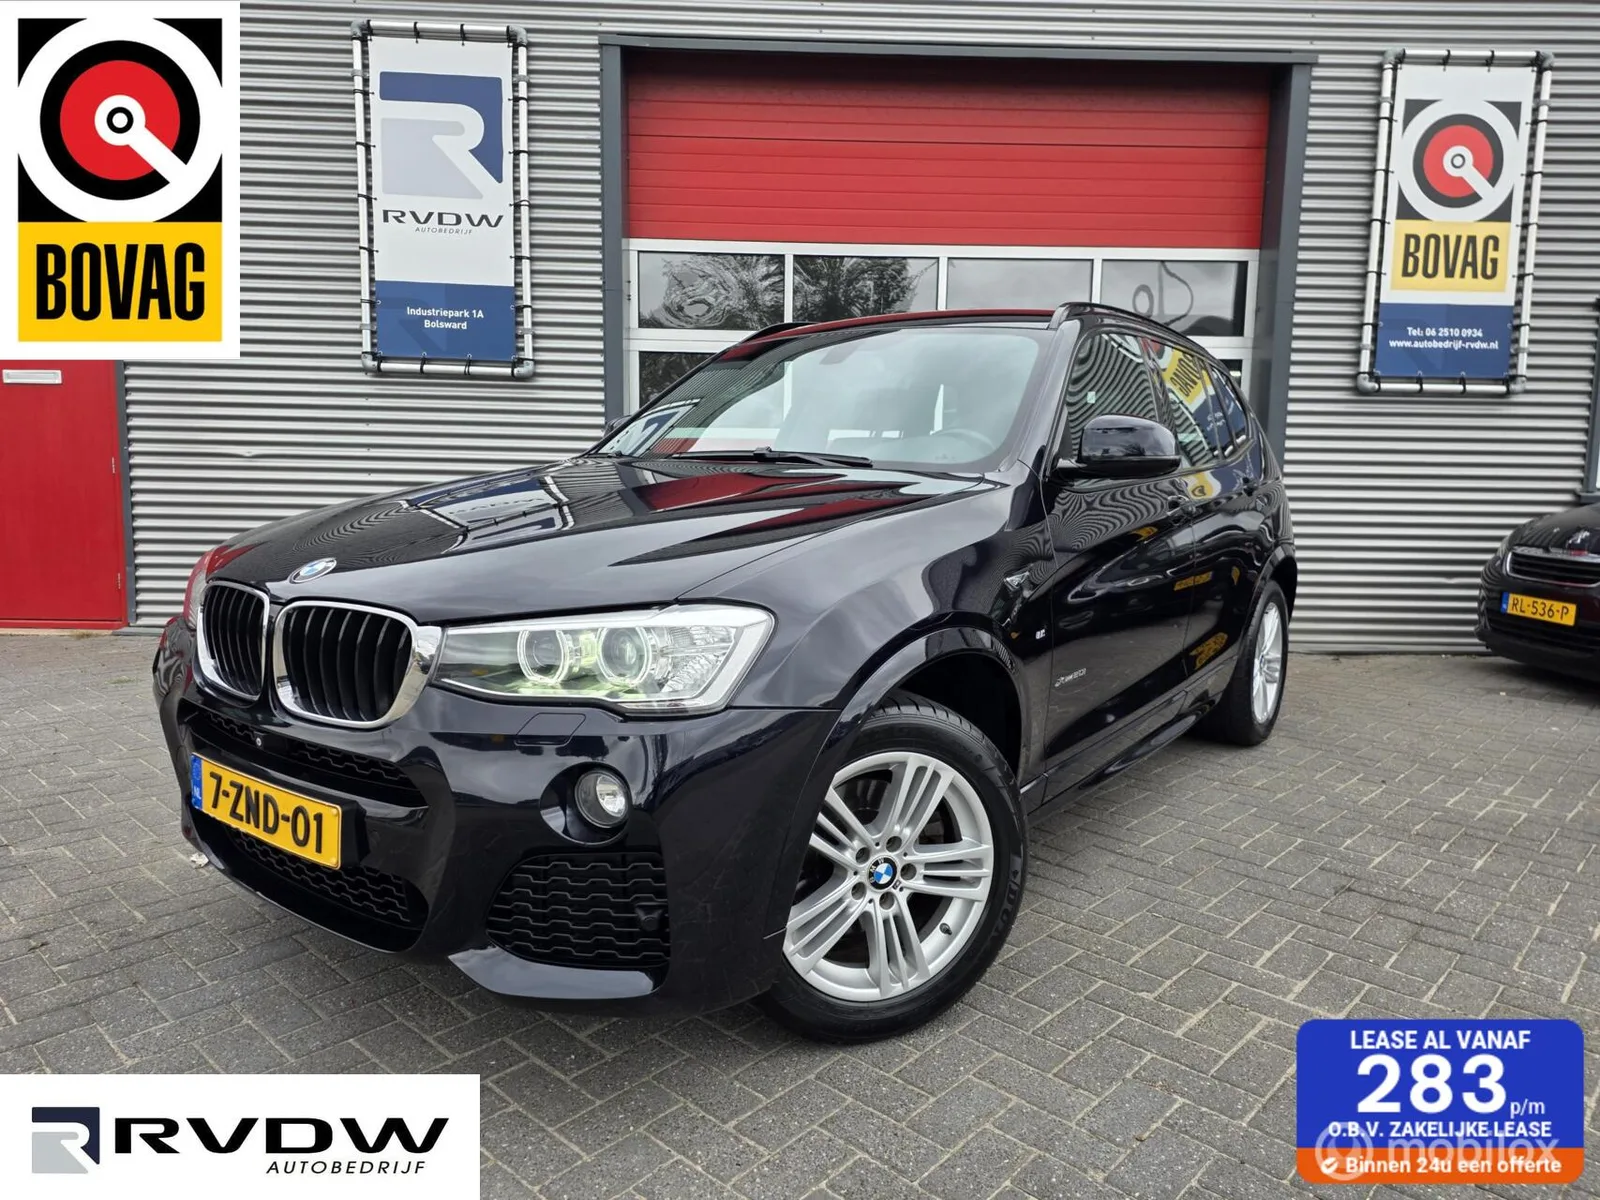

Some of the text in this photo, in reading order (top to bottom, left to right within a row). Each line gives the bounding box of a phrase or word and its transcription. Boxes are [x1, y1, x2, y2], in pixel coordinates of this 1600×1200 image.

[383, 209, 504, 228] RVDW
[415, 227, 473, 235] AUTOBEDRIJF
[1401, 233, 1500, 280] BOVAG
[407, 307, 484, 319] Industriepark 1A
[424, 320, 467, 329] Bolsward
[1407, 327, 1483, 337] Tel: 06 2510 0934
[1389, 339, 1499, 351] www.autobedrijf-rvdw.nl
[1511, 597, 1569, 621] RL-536-P
[209, 771, 323, 854] 7-ZND-01
